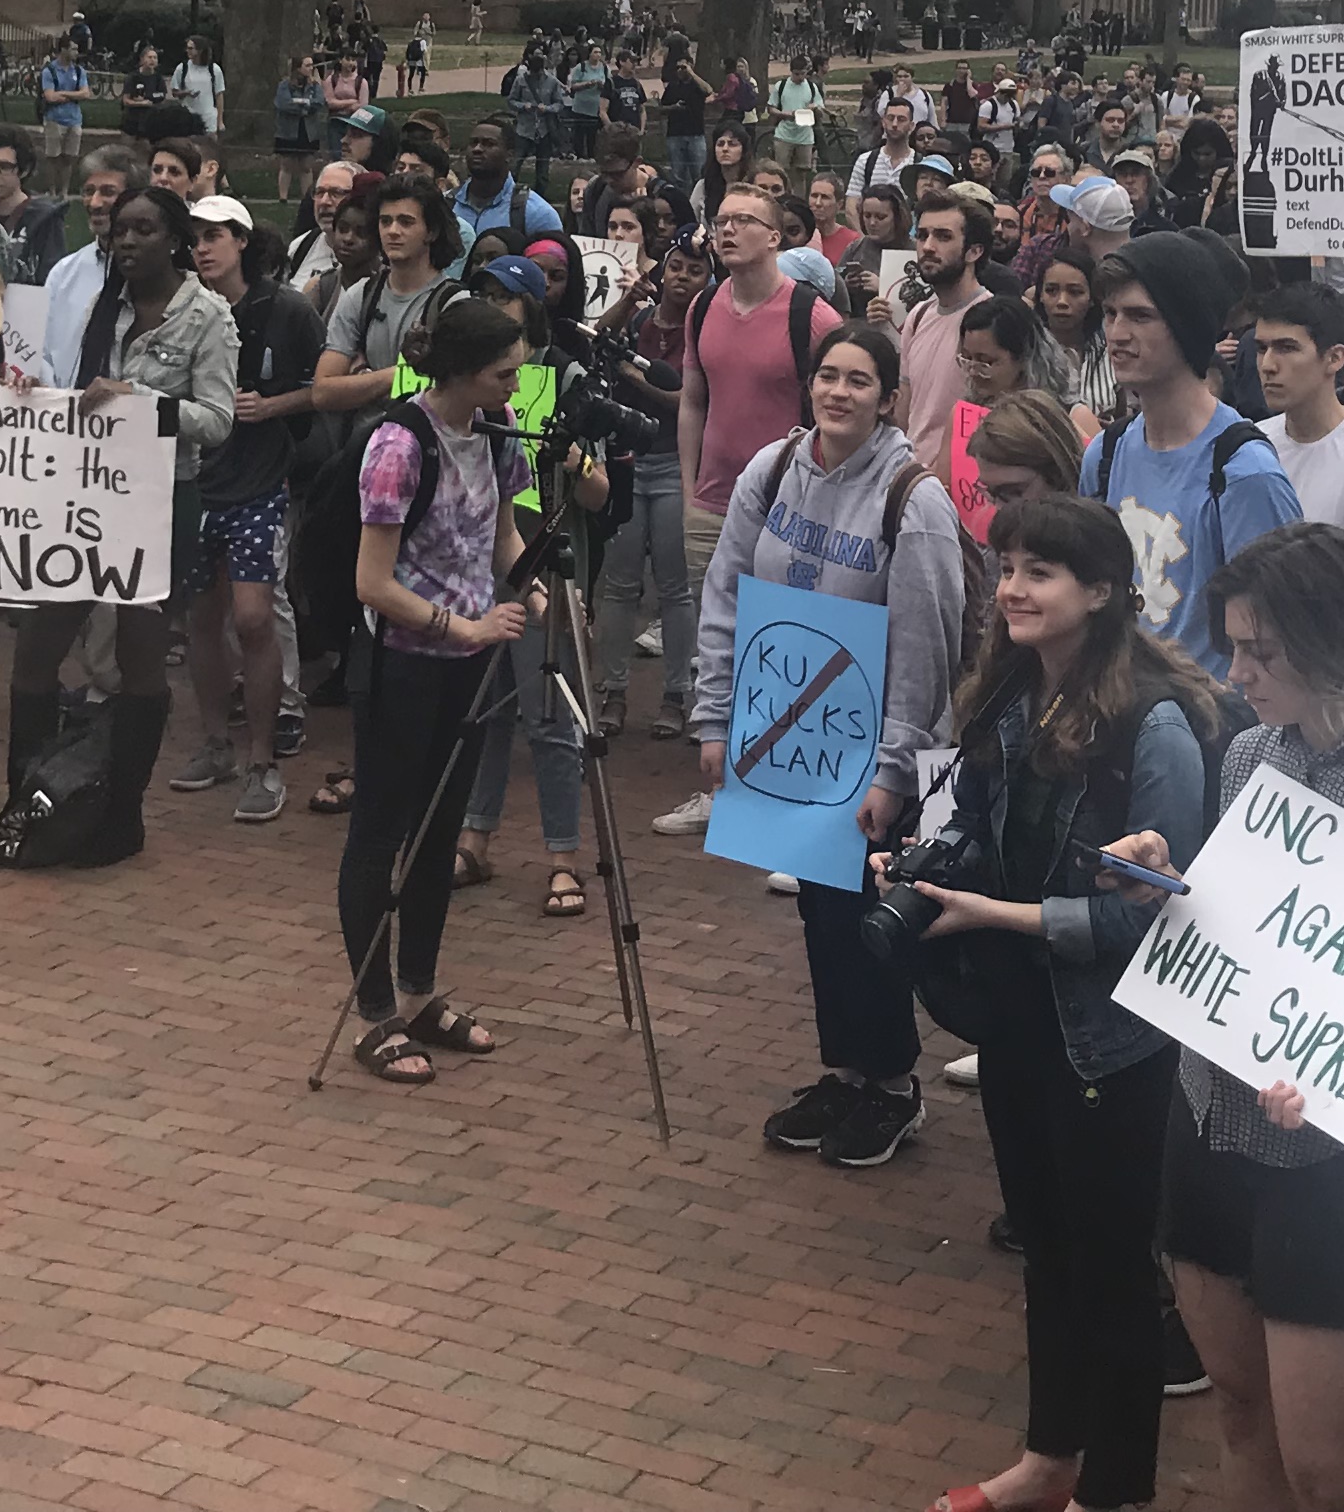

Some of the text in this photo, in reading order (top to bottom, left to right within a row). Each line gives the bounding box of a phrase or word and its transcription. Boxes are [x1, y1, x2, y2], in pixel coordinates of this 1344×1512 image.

[1244, 35, 1279, 47] SMASH
[1281, 33, 1315, 45] WHITE
[1286, 199, 1310, 211] text
[1327, 237, 1340, 249] to
[76, 446, 131, 495] the
[65, 500, 103, 542] is
[758, 640, 808, 688] KU
[747, 685, 867, 740] KUCKS
[1039, 693, 1064, 729] Nikon
[740, 729, 844, 782] KLAN
[1243, 783, 1338, 866] UNC
[1143, 915, 1251, 1027] WHITE
